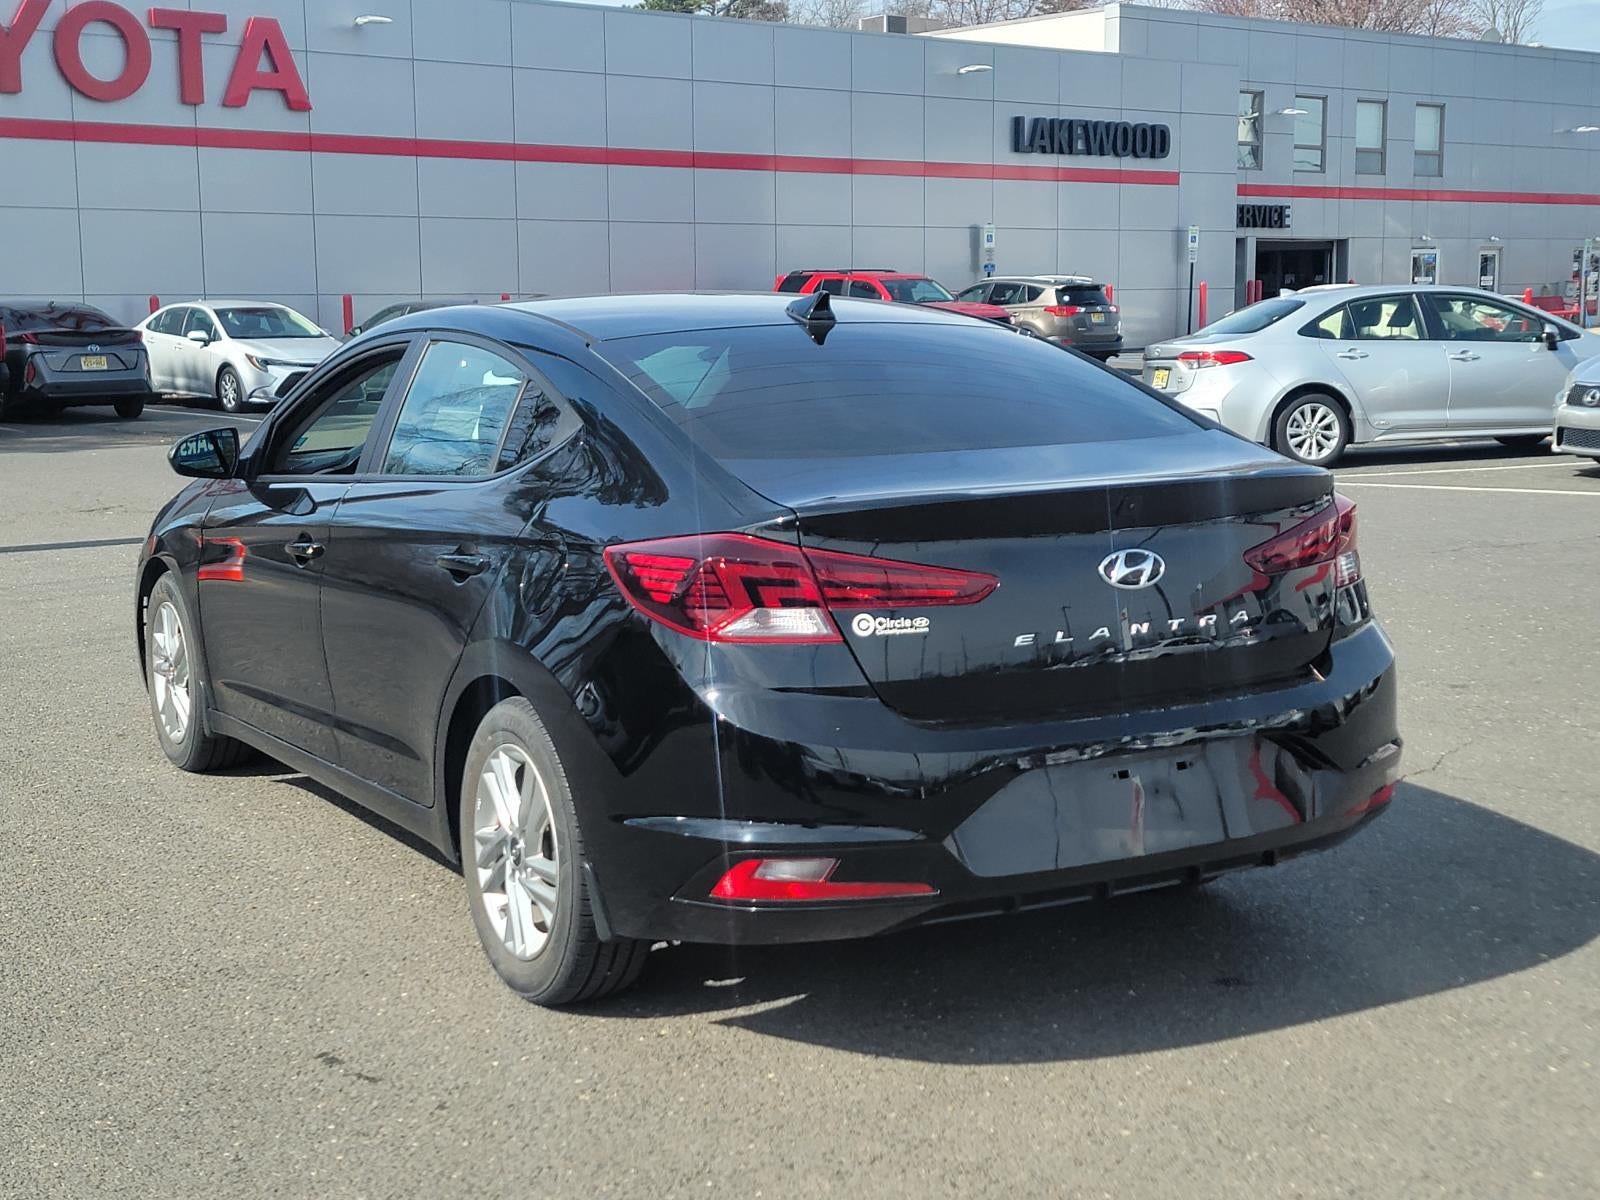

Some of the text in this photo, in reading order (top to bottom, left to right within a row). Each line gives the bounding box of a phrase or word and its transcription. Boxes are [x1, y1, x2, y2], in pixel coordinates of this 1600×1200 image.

[1012, 116, 1171, 159] LAKEWOOD
[875, 617, 912, 630] Circle
[1014, 610, 1249, 646] ELANTRA
